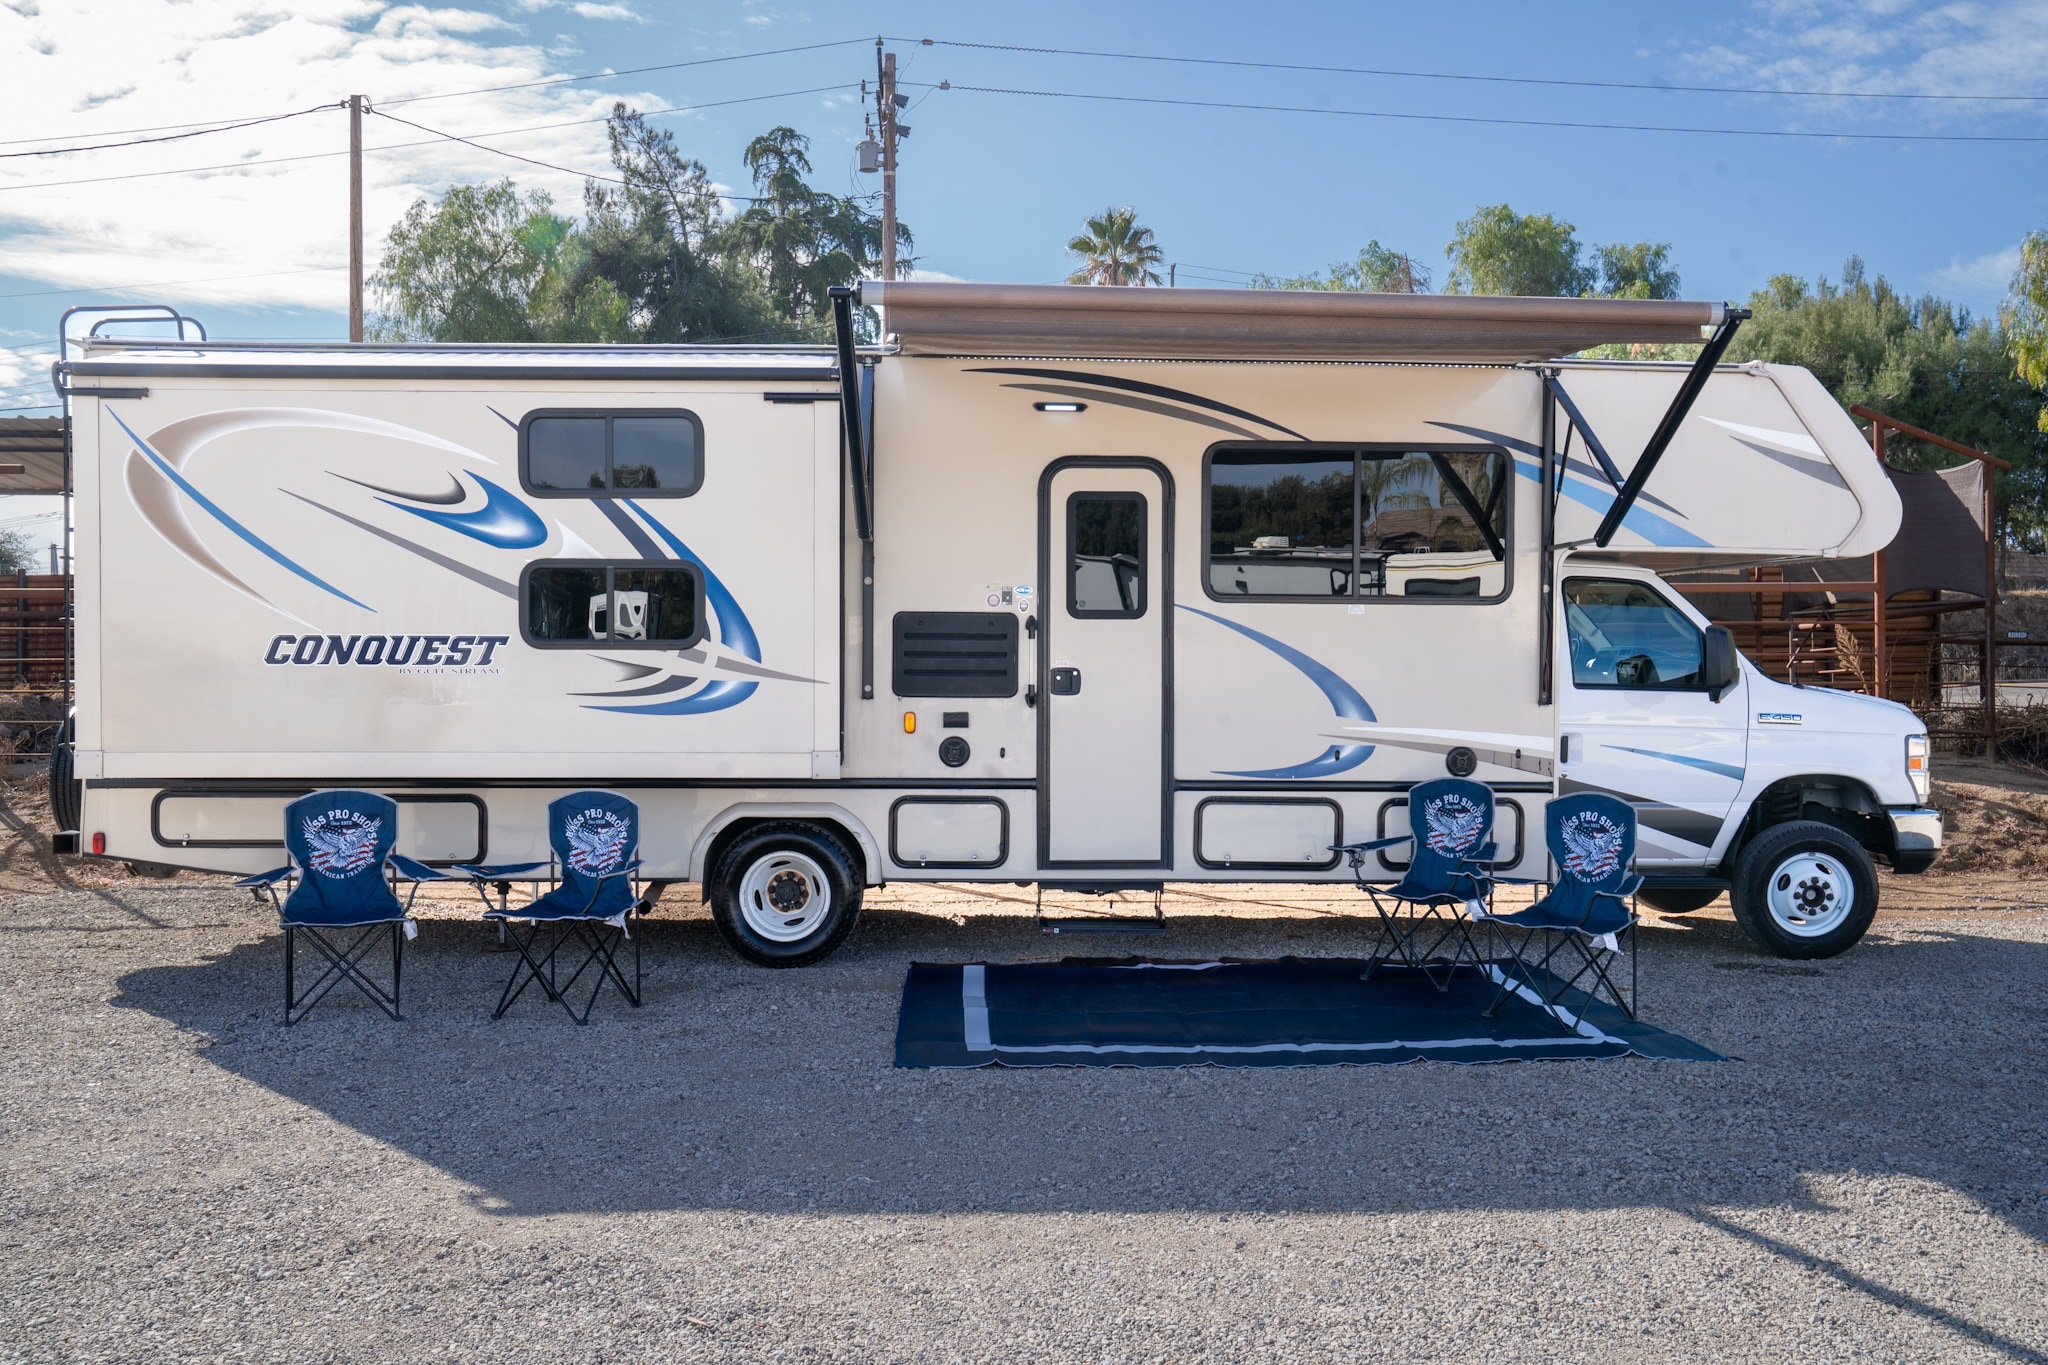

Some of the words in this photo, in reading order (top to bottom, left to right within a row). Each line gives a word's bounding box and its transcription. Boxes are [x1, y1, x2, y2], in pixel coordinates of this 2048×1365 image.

[263, 634, 511, 666] CONQUEST
[565, 814, 585, 838] BASS
[584, 808, 603, 819] PRO
[604, 811, 628, 838] SHOPS
[1426, 798, 1442, 821] BASS
[1443, 794, 1460, 804] PRO
[1460, 797, 1483, 823] SHOPS
[304, 815, 327, 840] BASS
[327, 809, 350, 820] PRO
[351, 812, 377, 839] SHOPS
[1562, 816, 1579, 840] BASS
[1579, 811, 1598, 822] PRO
[1598, 815, 1623, 845] SHOPS
